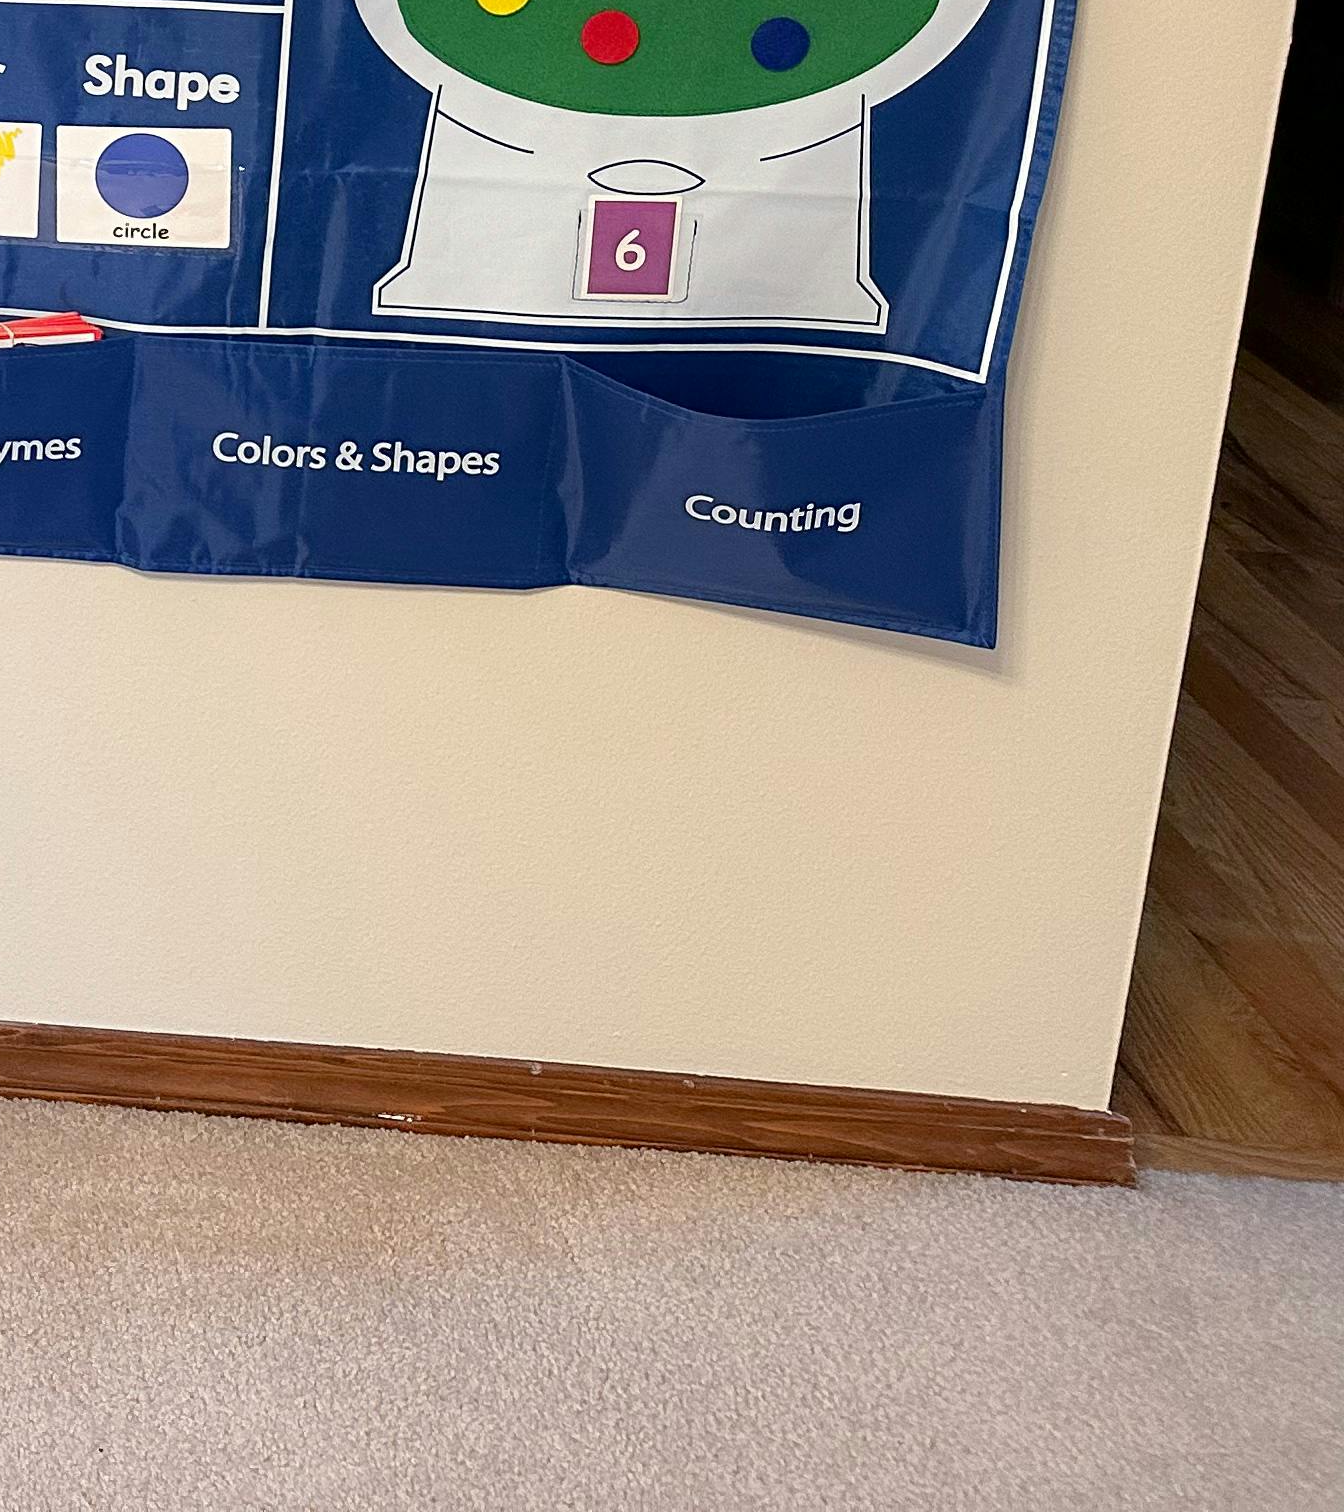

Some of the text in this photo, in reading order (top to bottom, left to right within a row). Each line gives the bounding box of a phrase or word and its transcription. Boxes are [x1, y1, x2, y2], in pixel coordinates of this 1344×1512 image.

[83, 54, 241, 106] Shape
[112, 222, 170, 240] circle
[615, 229, 646, 272] 6
[212, 433, 500, 482] Colors & Shapes
[684, 494, 861, 533] Counting
